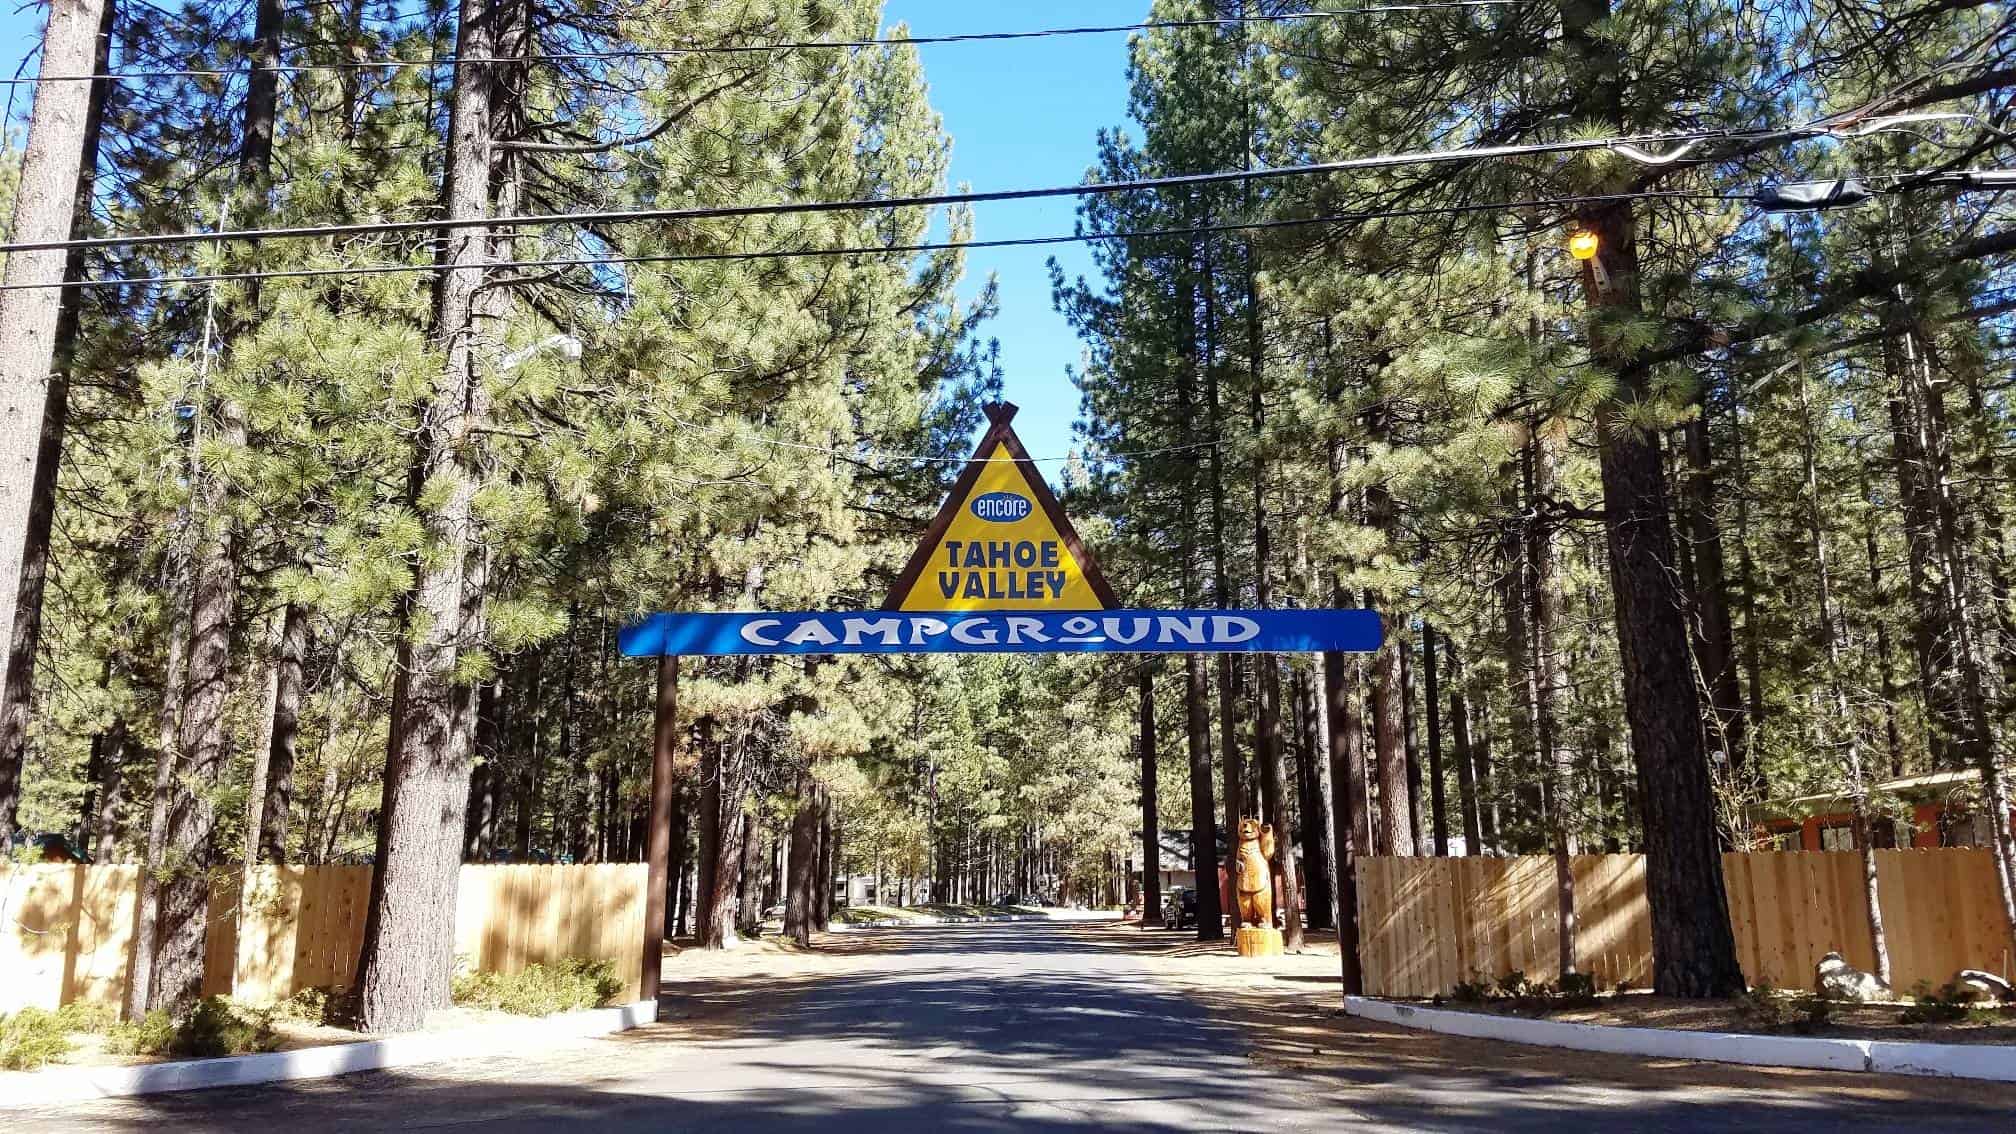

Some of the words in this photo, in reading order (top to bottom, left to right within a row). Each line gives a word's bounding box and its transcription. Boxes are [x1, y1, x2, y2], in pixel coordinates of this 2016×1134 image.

[977, 498, 1027, 517] encore
[945, 541, 1059, 568] TAHOE
[938, 571, 1066, 599] VALLEY
[740, 616, 1260, 646] CAMPGROUND
